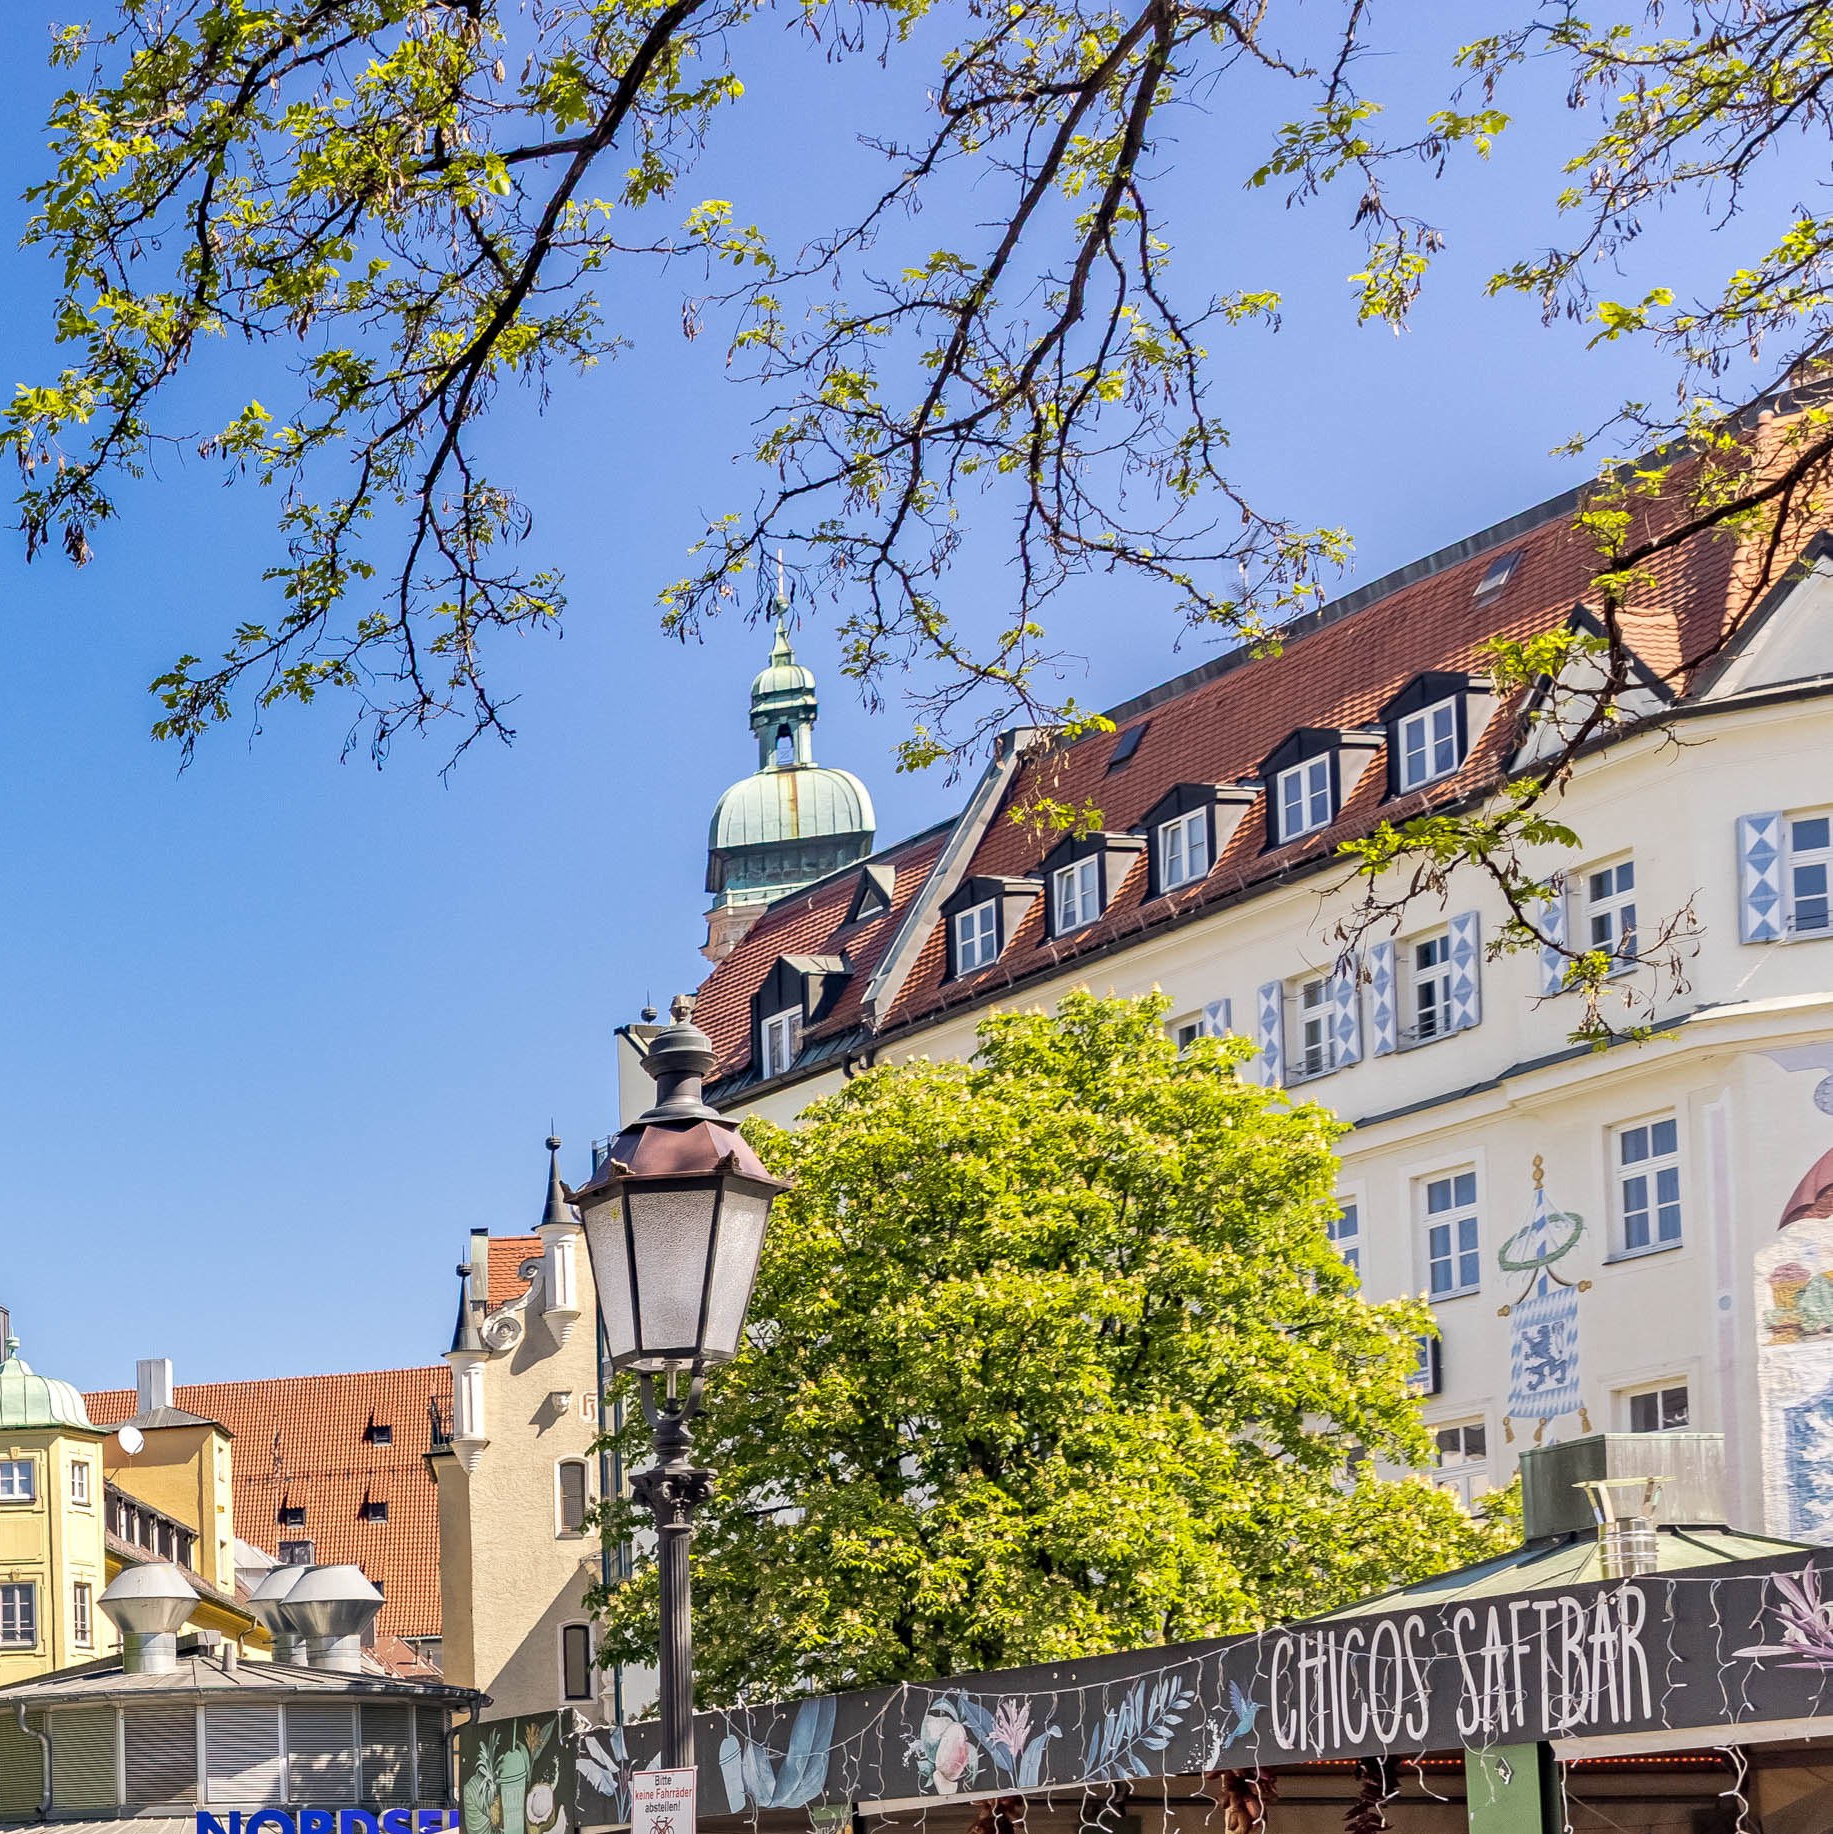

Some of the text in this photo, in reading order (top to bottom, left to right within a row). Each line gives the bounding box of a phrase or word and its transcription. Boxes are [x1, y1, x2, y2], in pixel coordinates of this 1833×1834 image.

[1270, 1585, 1652, 1750] CHICOS SAFTBAR
[653, 1775, 673, 1786] Bitte
[635, 1786, 692, 1800] keine Fahrräder
[644, 1801, 681, 1813] abstellen!
